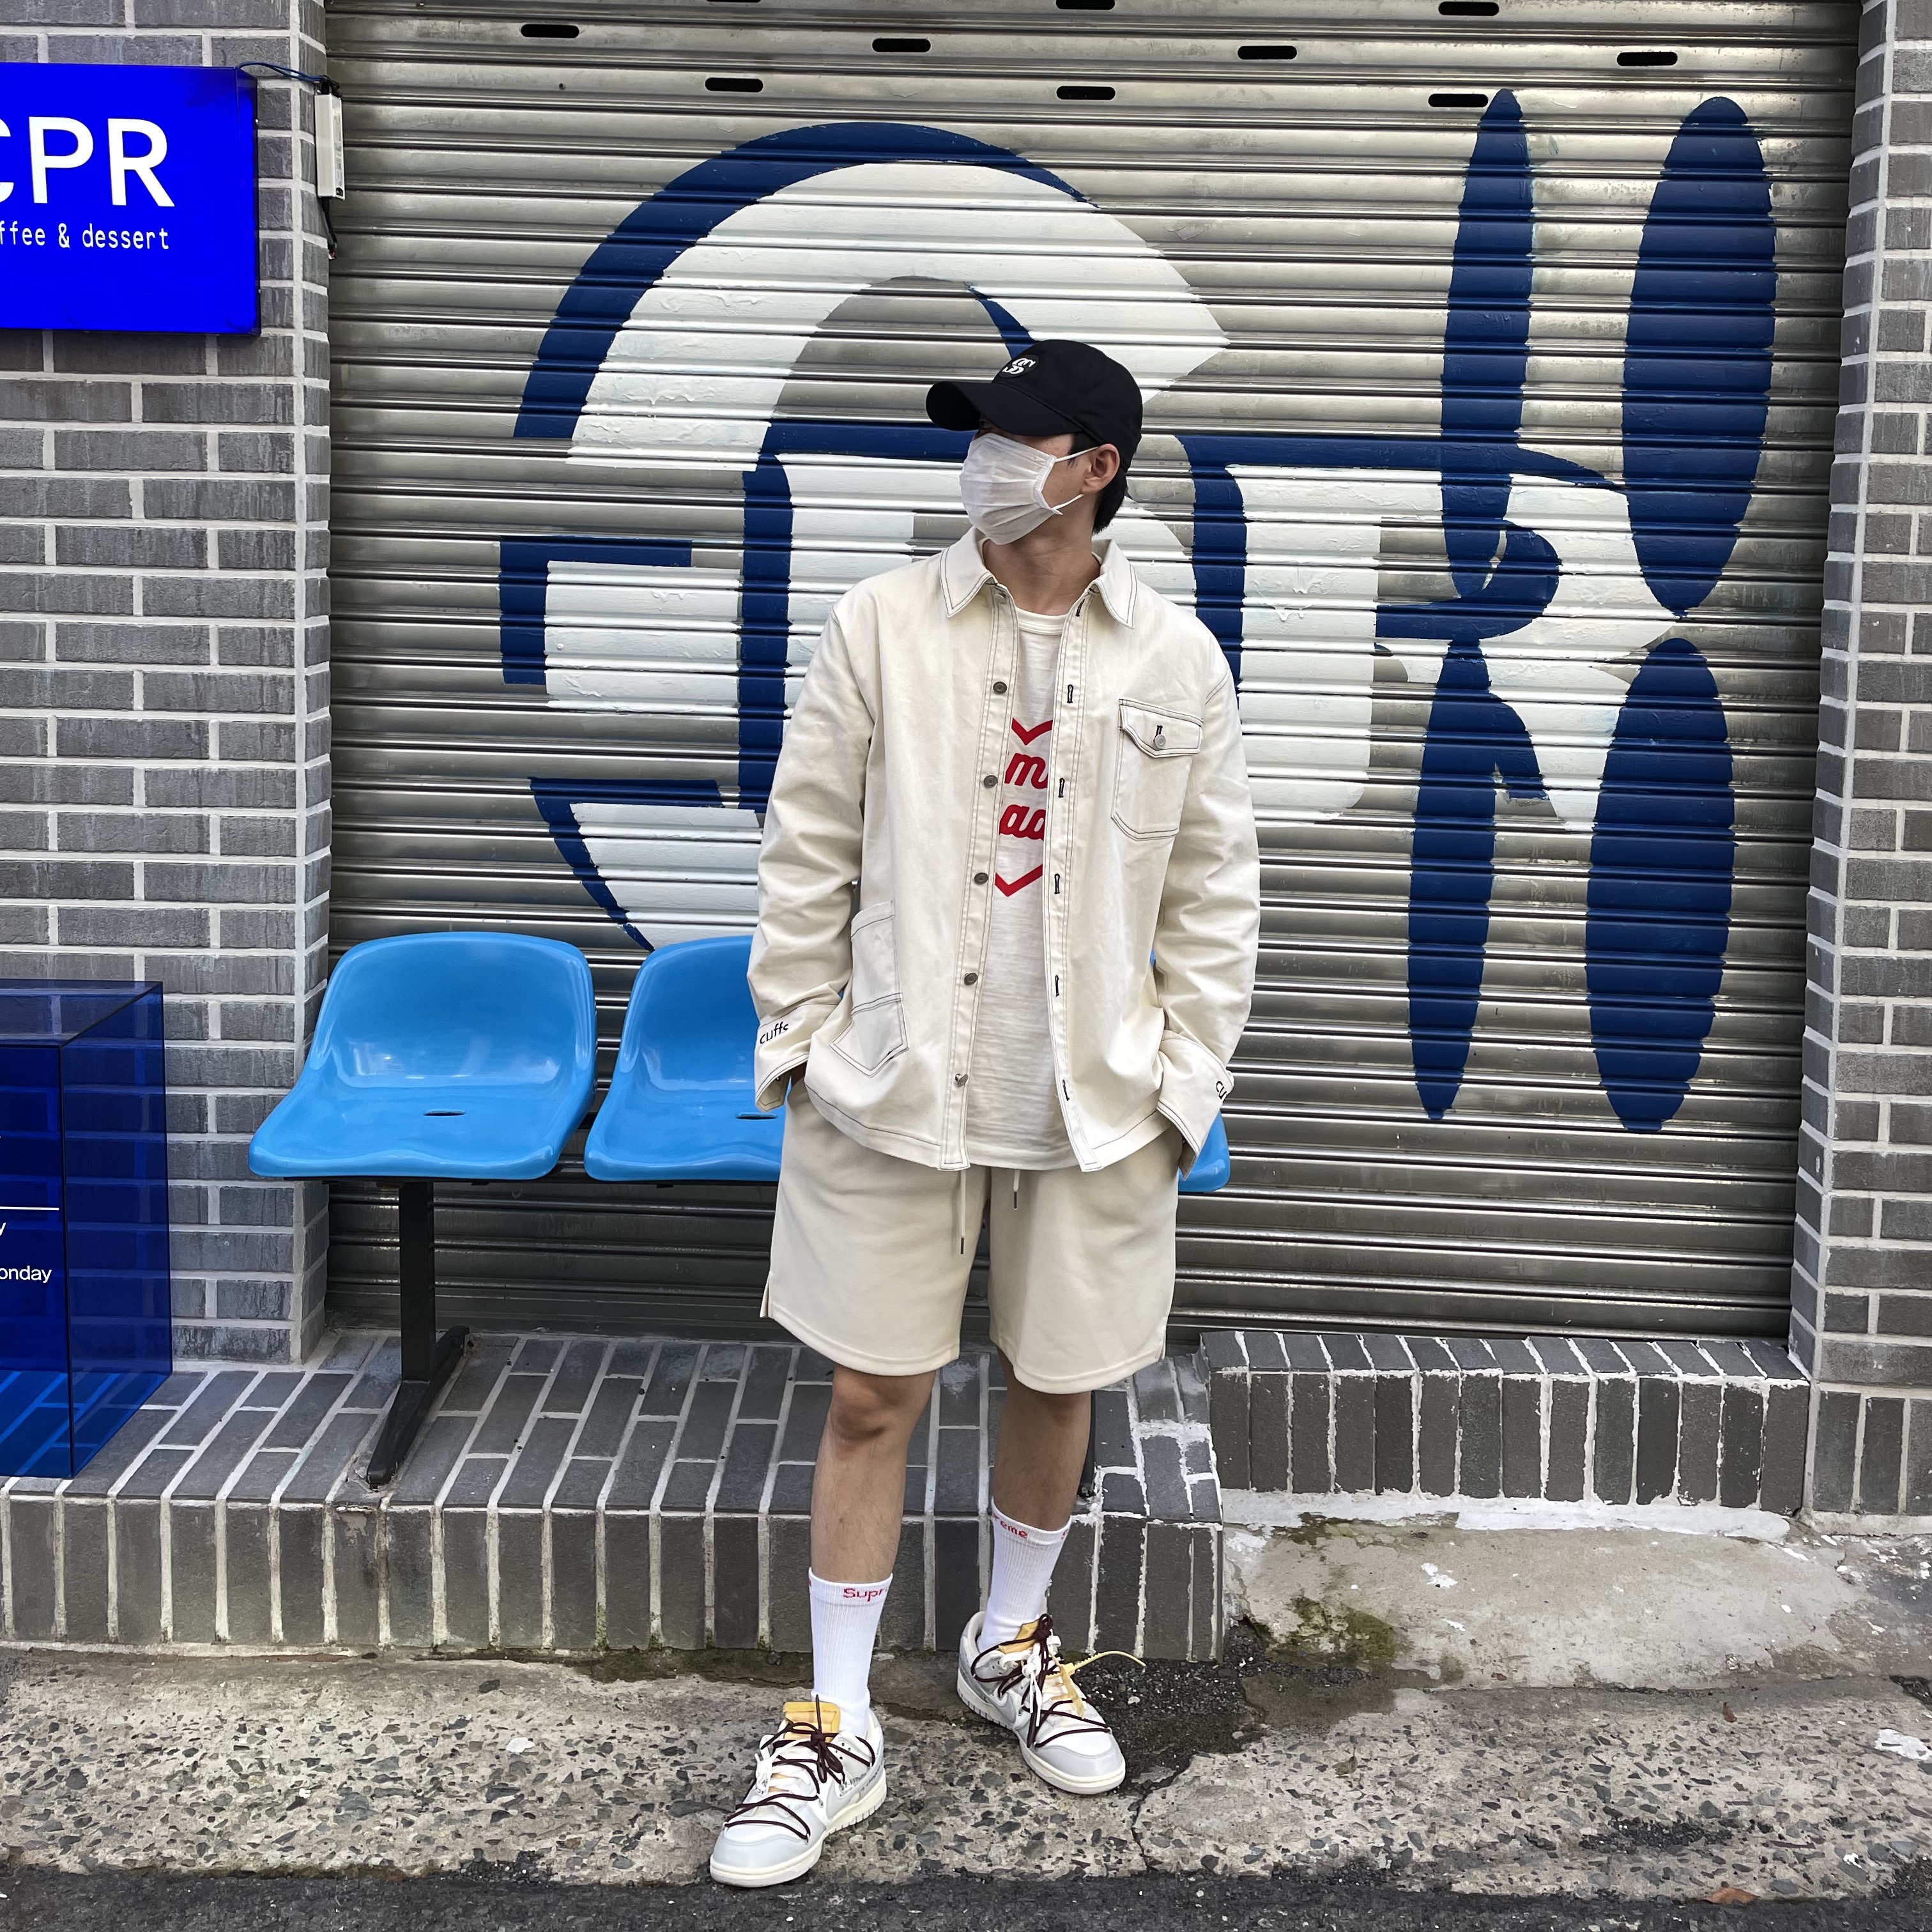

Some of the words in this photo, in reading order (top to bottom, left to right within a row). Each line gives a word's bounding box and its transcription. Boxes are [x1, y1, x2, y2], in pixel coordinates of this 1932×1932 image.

[0, 116, 175, 207] PR
[58, 223, 70, 248] &
[82, 222, 169, 250] dessert
[1216, 1080, 1230, 1103] cu
[843, 1587, 889, 1602] Supr
